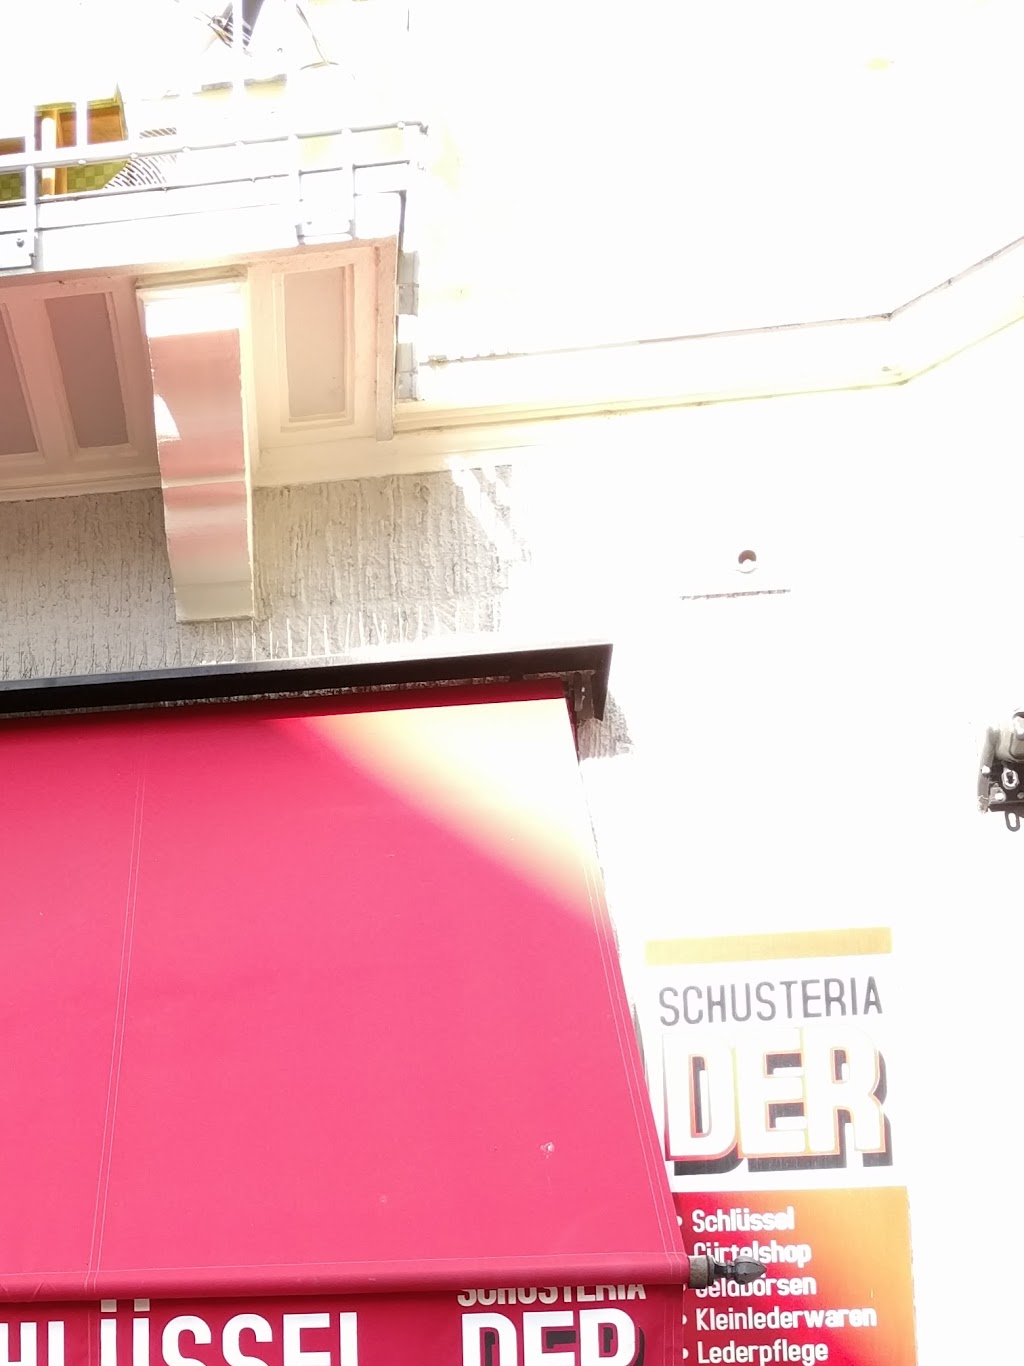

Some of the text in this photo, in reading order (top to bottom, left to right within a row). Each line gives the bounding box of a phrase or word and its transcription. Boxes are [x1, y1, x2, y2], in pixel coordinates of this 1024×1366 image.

[659, 975, 883, 1026] SCHUSTERIA
[663, 1026, 893, 1176] DER
[692, 1207, 795, 1233] Schlüssel
[696, 1307, 877, 1332] Kleinlederwaren
